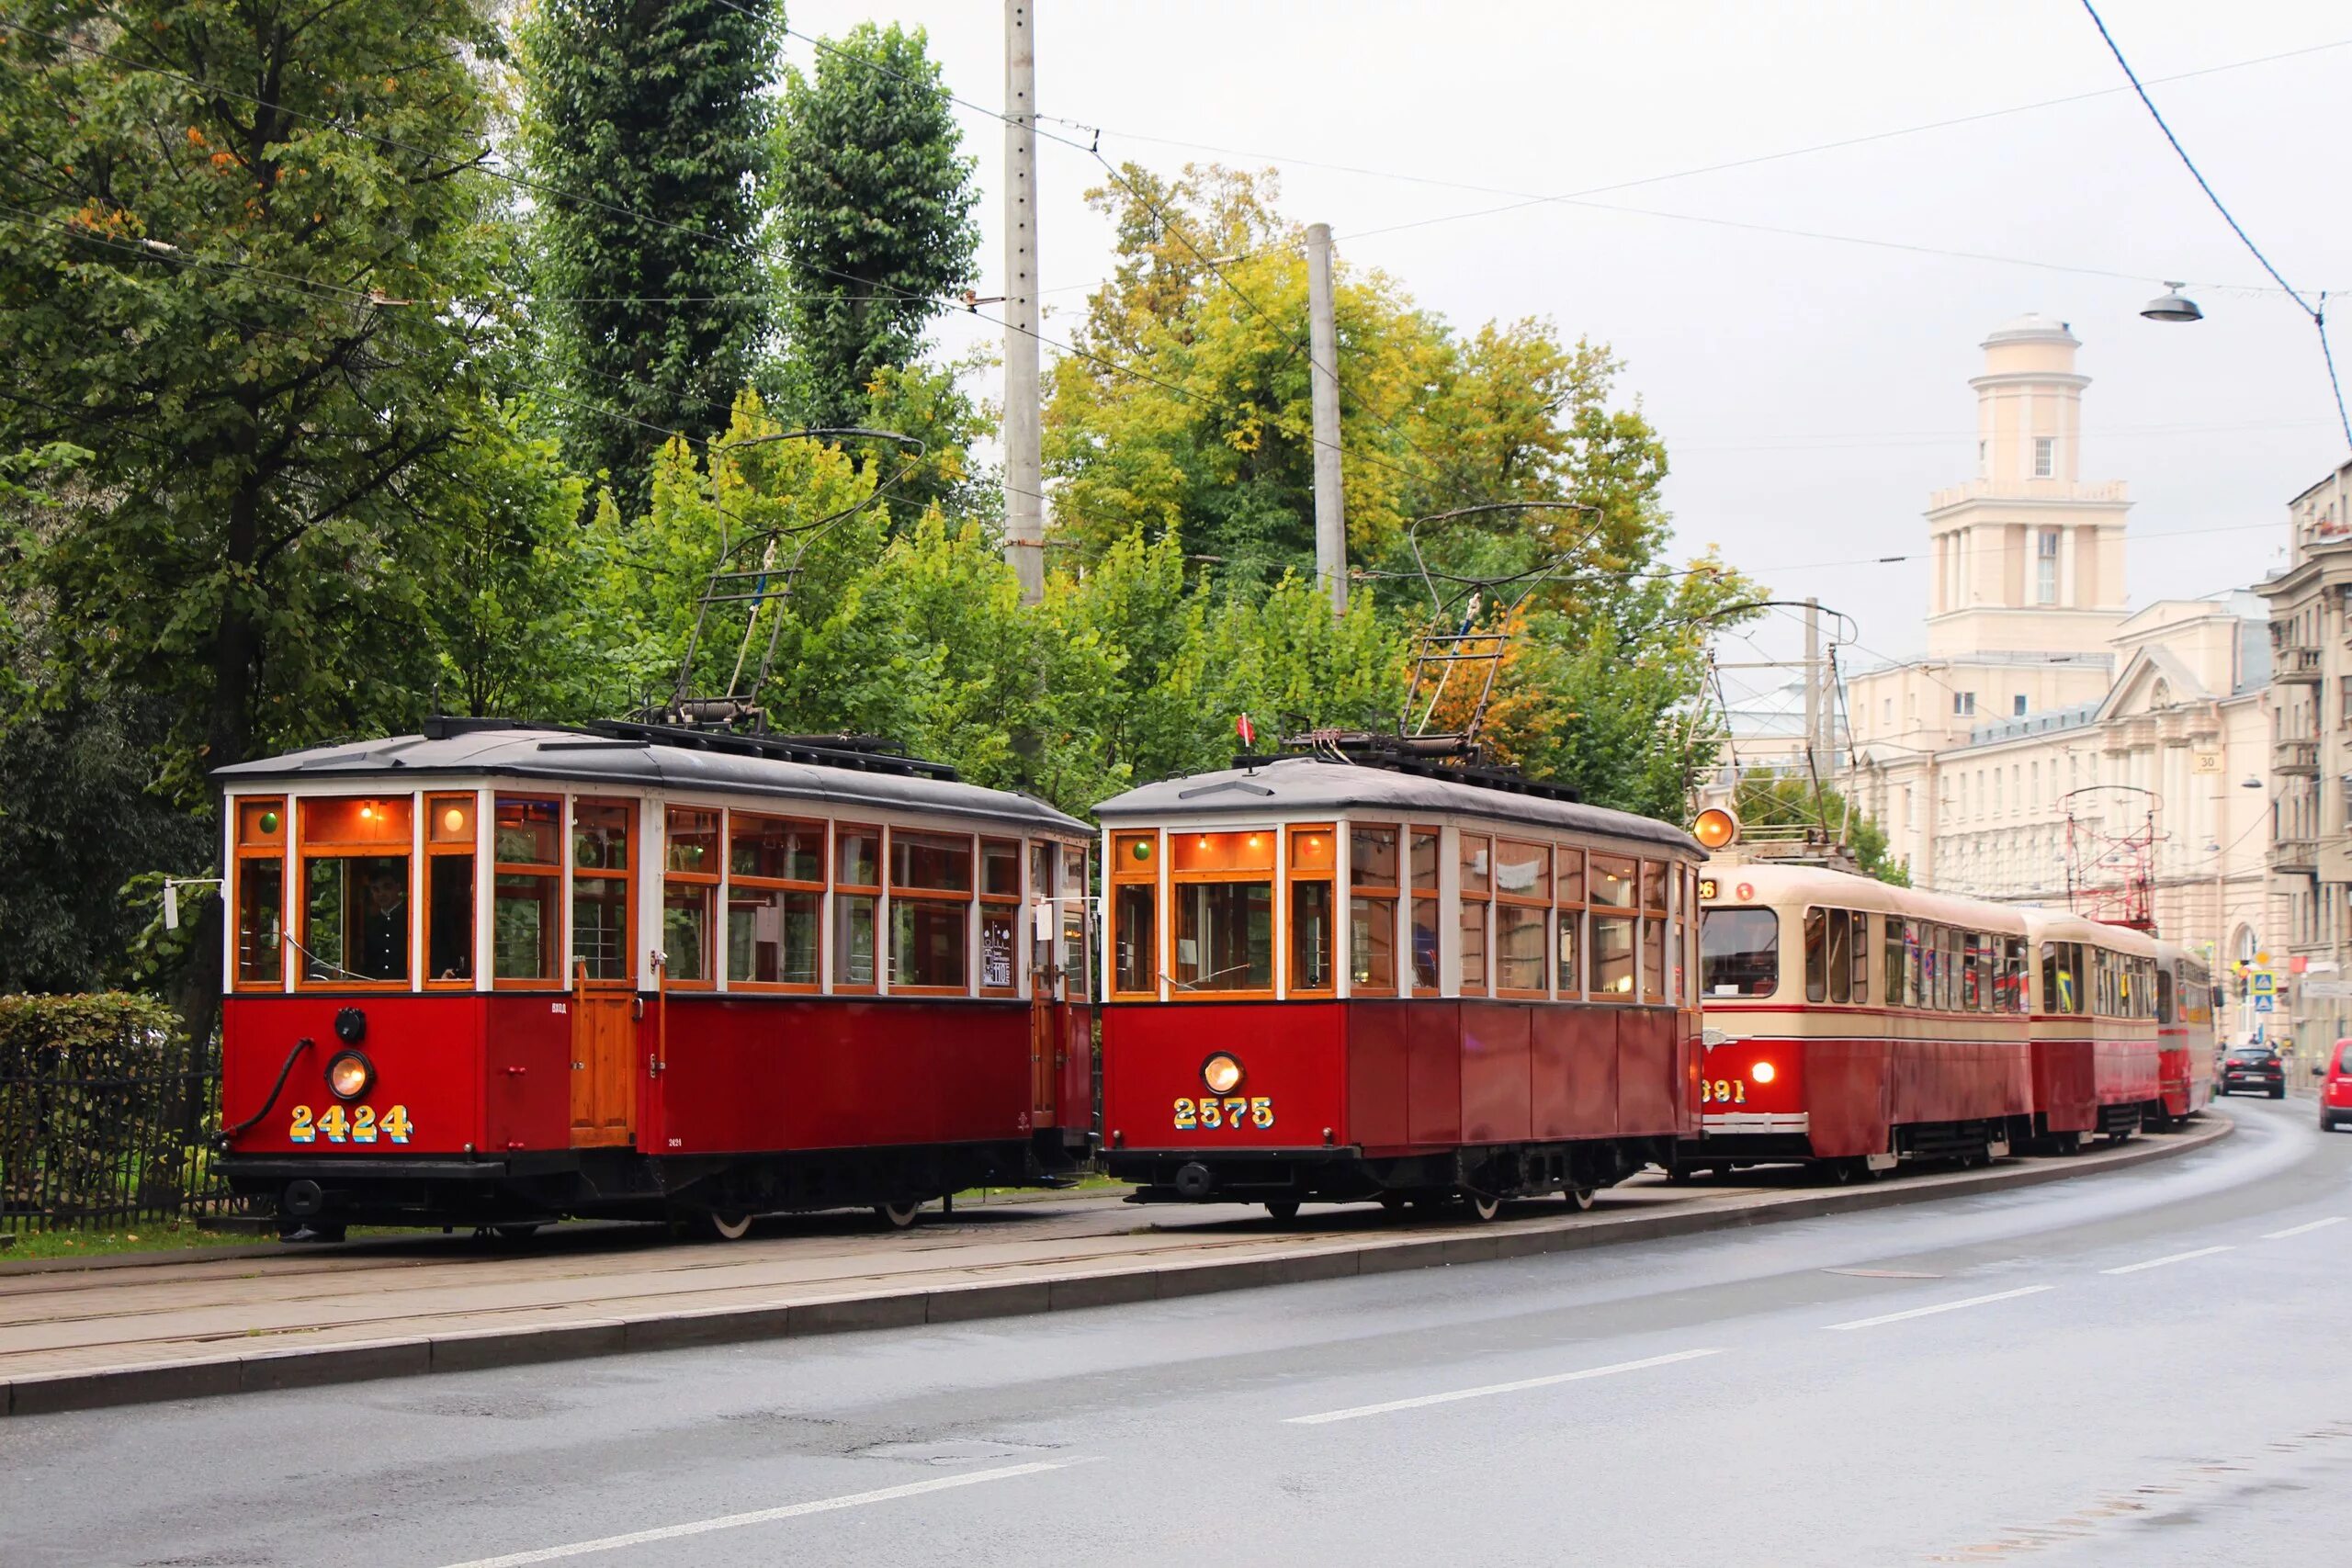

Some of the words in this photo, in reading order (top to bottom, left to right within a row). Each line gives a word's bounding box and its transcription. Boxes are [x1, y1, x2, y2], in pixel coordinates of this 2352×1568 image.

[2200, 756, 2215, 768] 30
[289, 1104, 413, 1144] 2424
[1173, 1097, 1274, 1130] 2575
